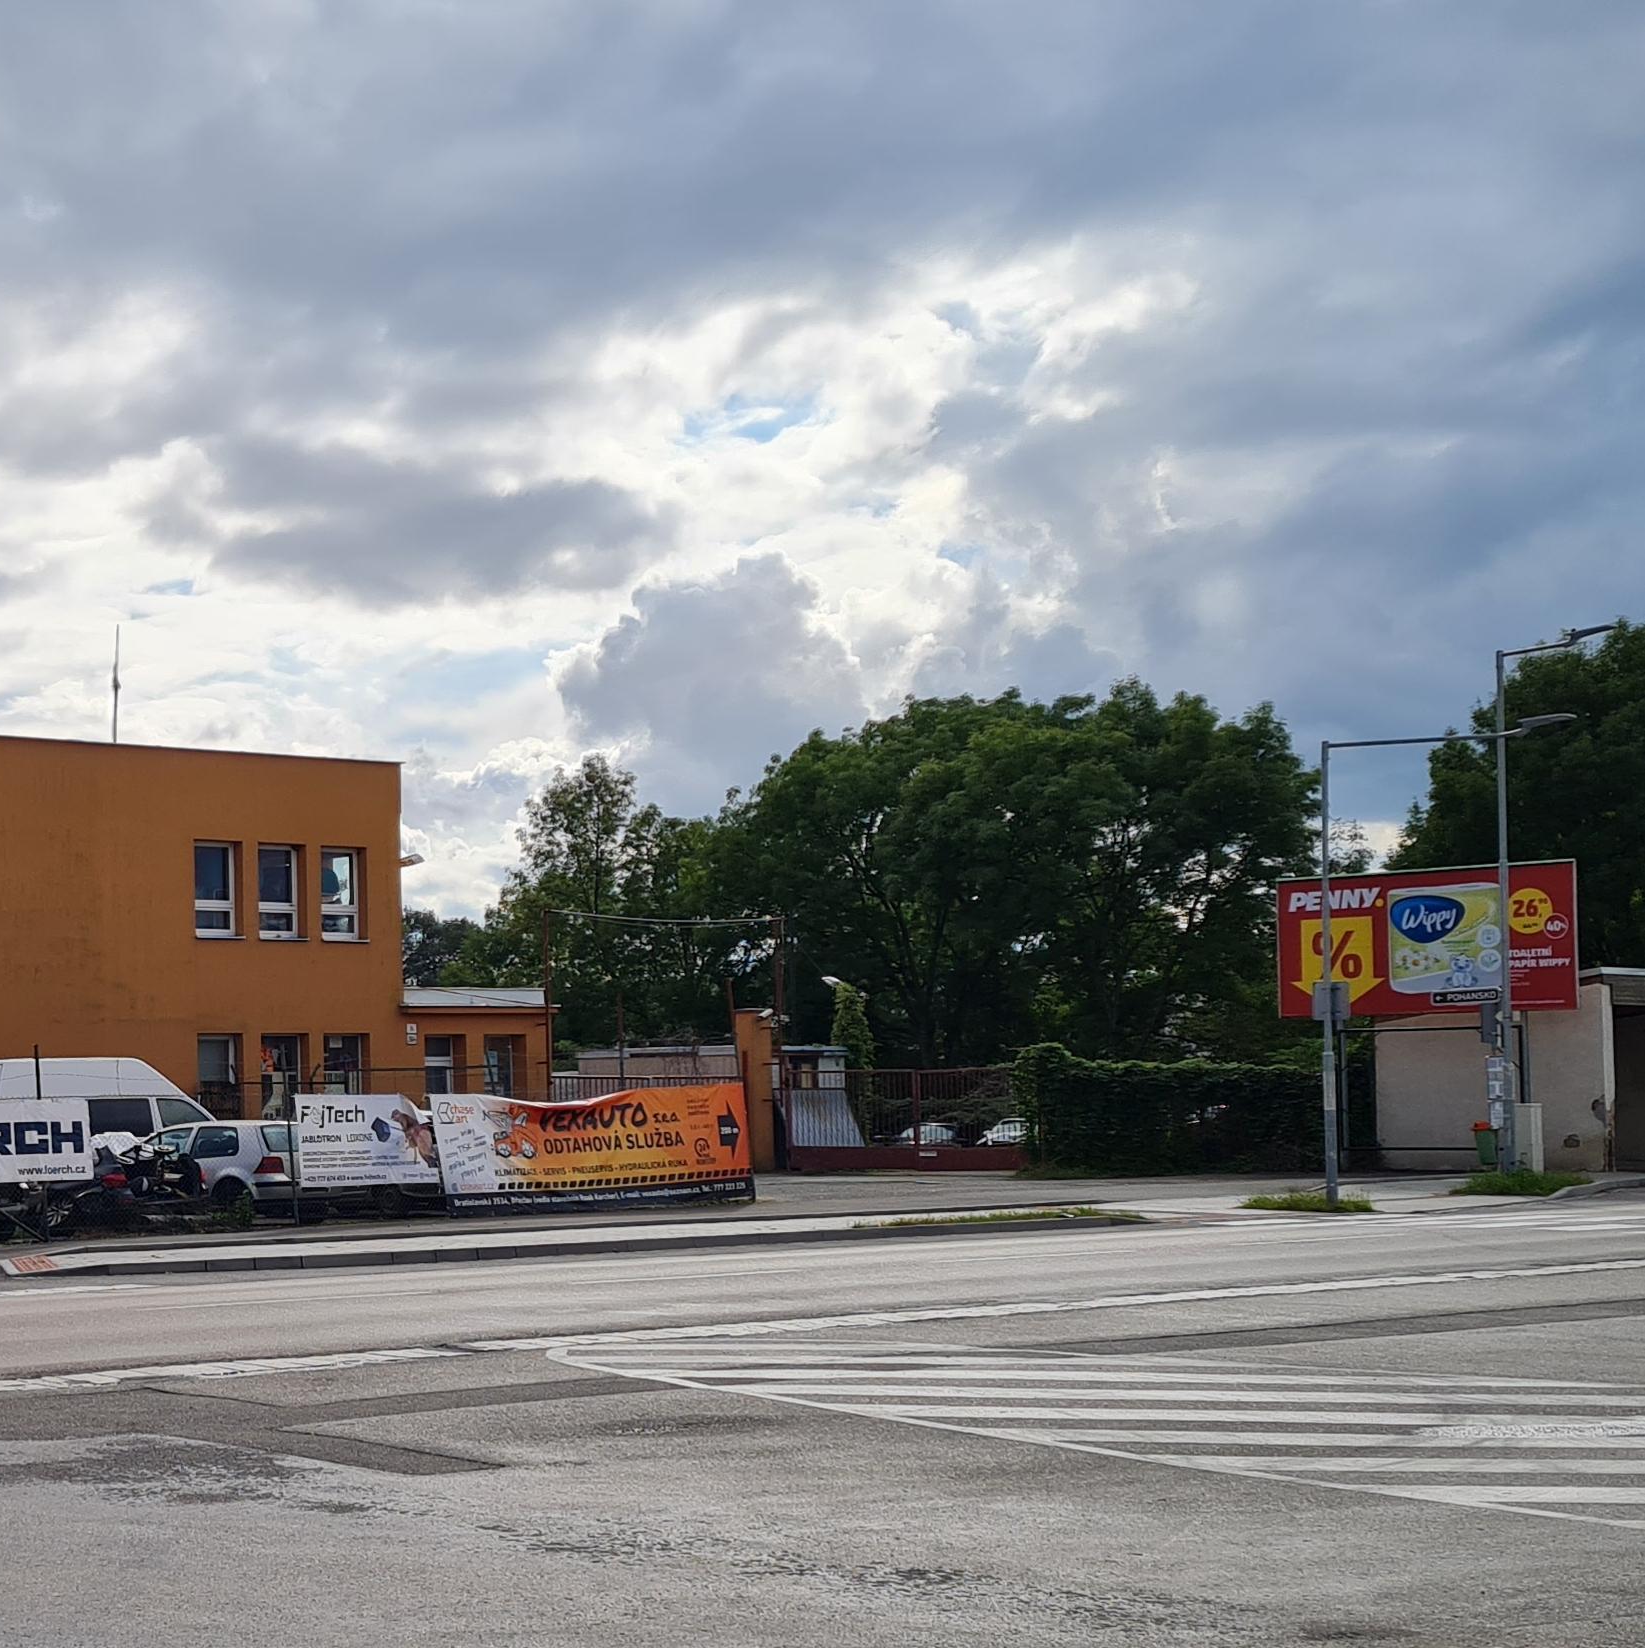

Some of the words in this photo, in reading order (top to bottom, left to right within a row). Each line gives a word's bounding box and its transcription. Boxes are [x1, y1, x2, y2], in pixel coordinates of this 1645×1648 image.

[1401, 904, 1458, 933] Wippy
[1538, 957, 1571, 967] WIPPY
[1446, 990, 1497, 1001] POHANSKO
[539, 1102, 648, 1132] VEXAUTO
[301, 1134, 342, 1143] JABLOTRON
[543, 1130, 622, 1154] ODTAHOVÁ
[625, 1127, 685, 1149] SLUŽBA
[542, 1166, 567, 1175] SERVIS
[572, 1163, 614, 1174] PNEUSERVIS
[618, 1159, 667, 1171] HYDRAULICKÁ
